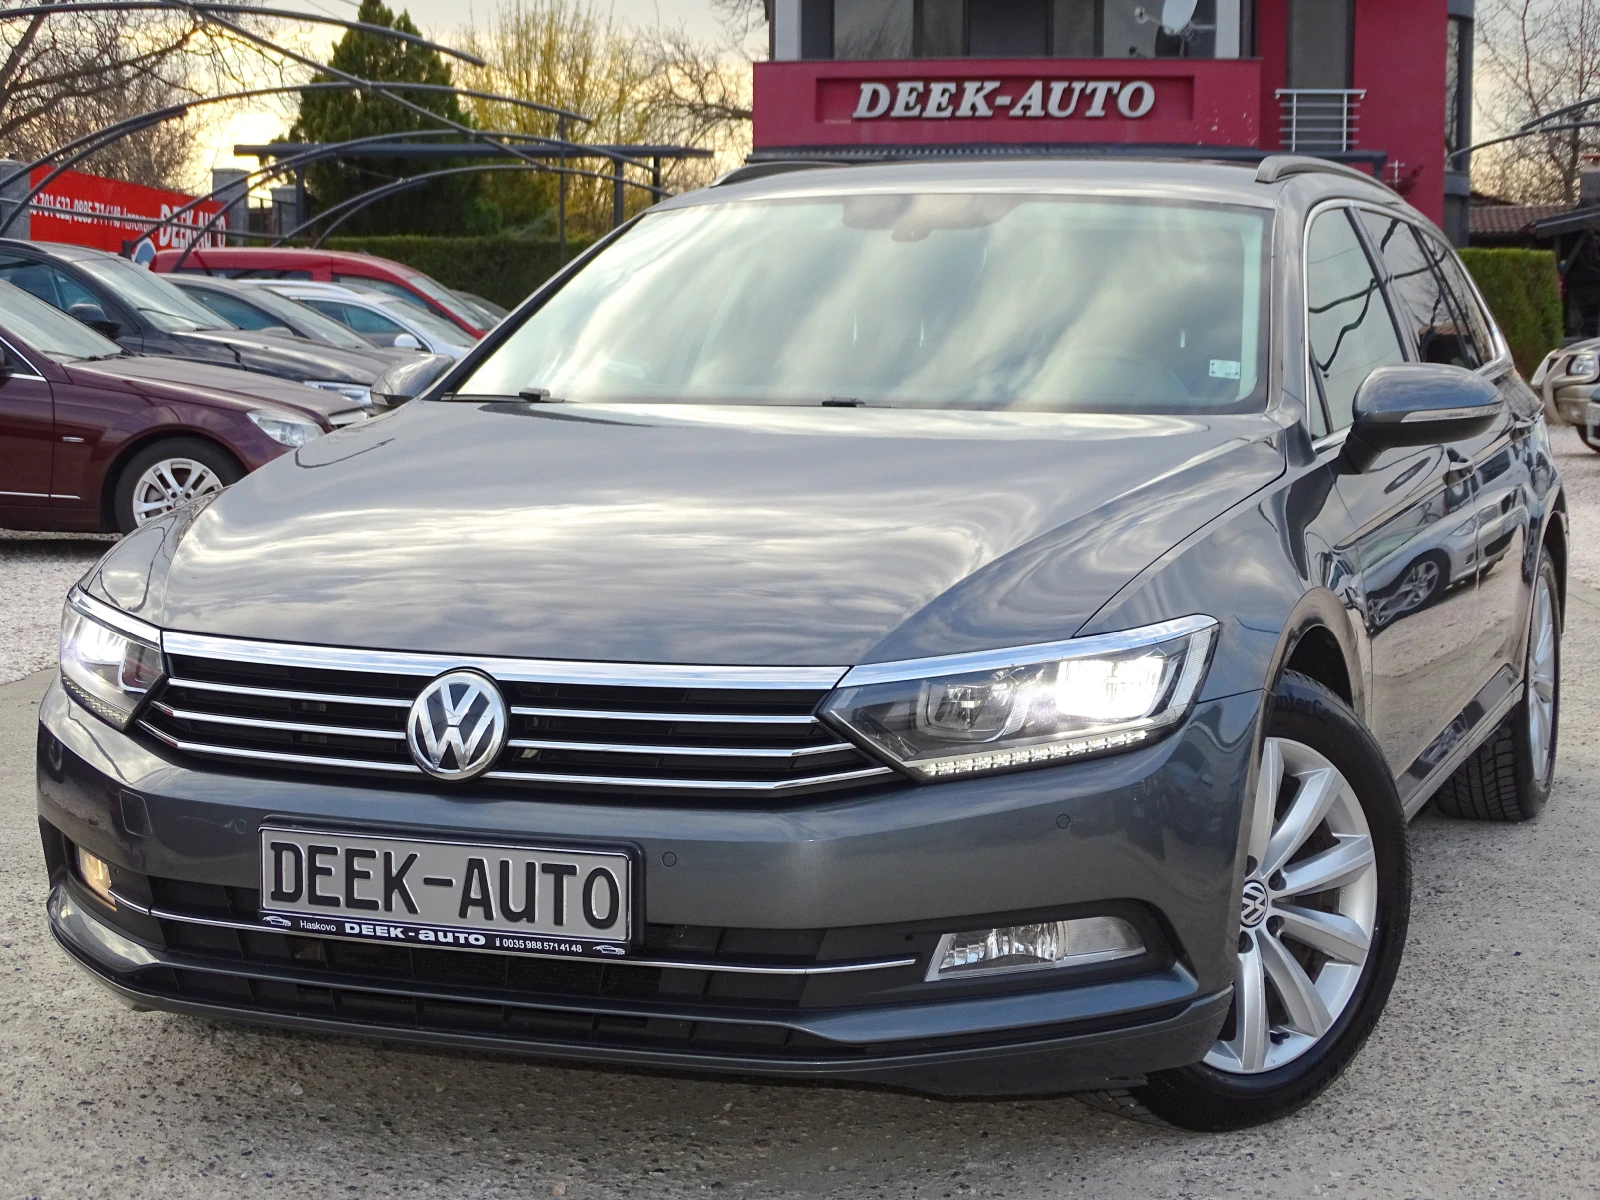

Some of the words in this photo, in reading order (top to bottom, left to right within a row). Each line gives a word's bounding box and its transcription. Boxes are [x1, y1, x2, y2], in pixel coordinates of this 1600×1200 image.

[852, 80, 1156, 118] DEEK-AUTO
[270, 841, 620, 930] DEEK-AUTO
[300, 920, 337, 932] Haskovo
[502, 938, 525, 949] 0035
[526, 940, 542, 951] 988
